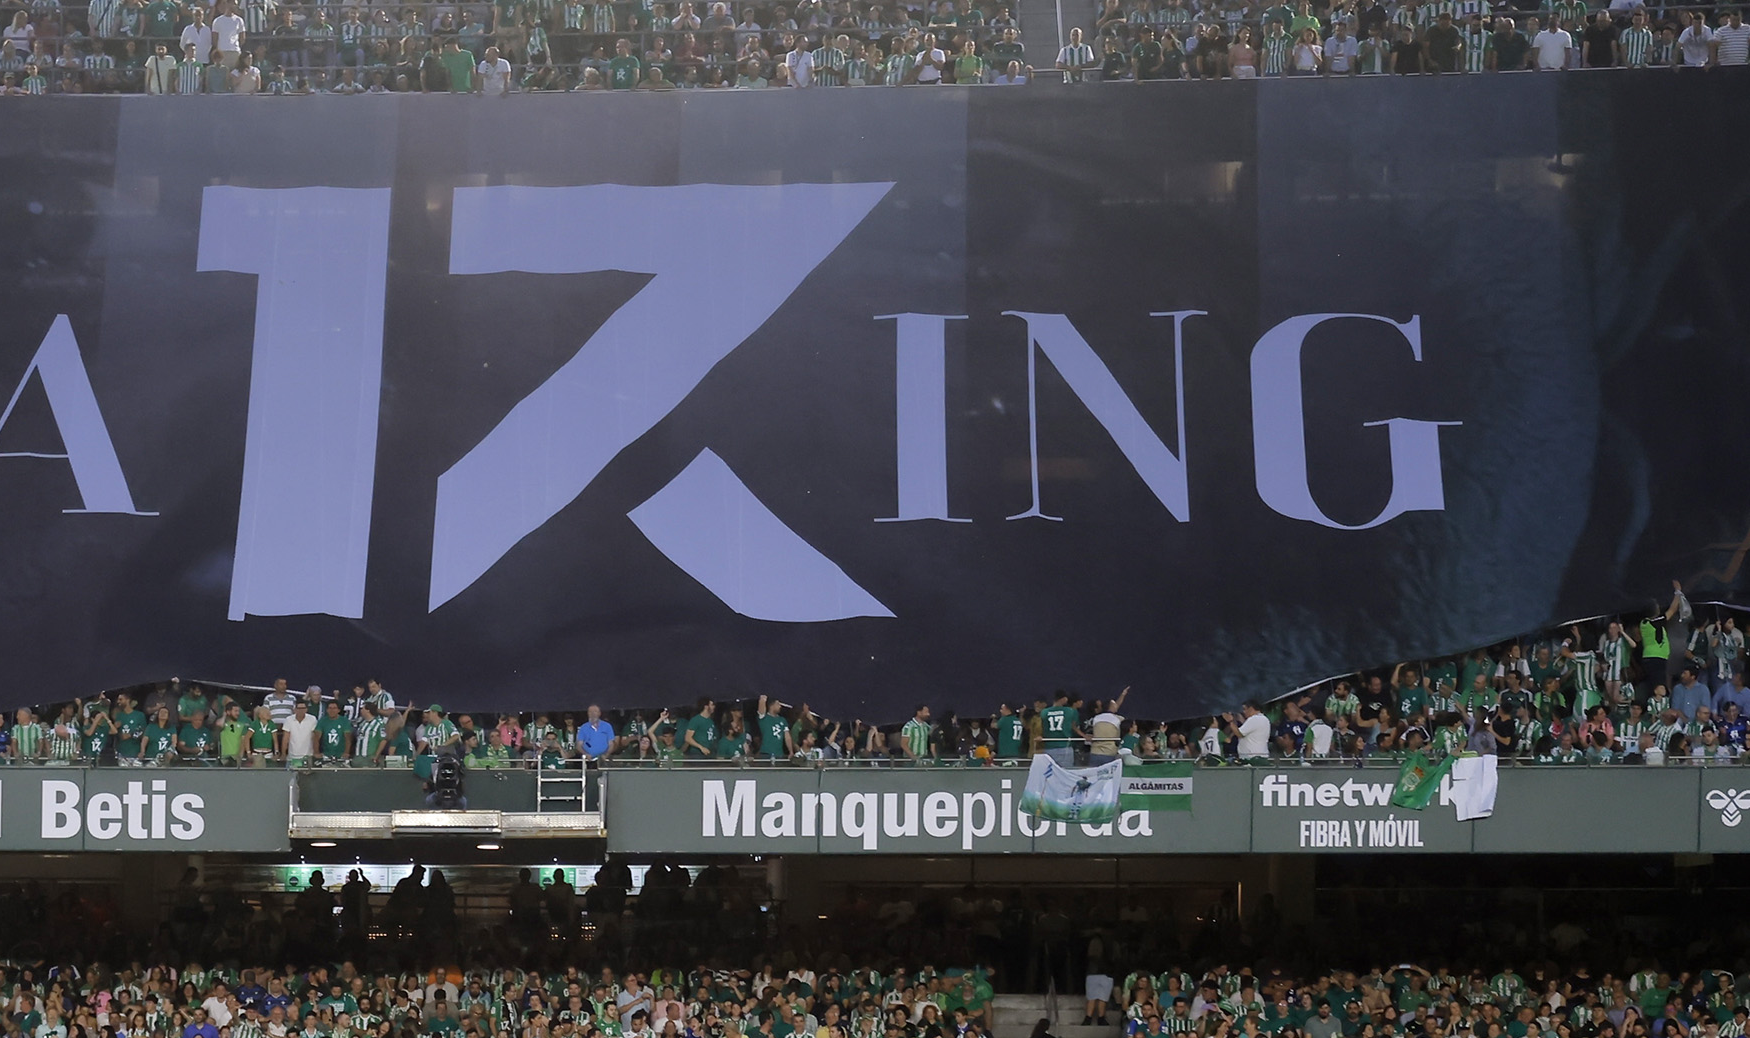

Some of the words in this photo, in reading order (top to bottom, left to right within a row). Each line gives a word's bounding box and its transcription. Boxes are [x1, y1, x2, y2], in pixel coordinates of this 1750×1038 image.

[40, 779, 205, 841] Betis
[701, 778, 1153, 850] Manquepia
[1259, 774, 1454, 806] finetwk
[1299, 819, 1352, 848] FIBRA
[1354, 819, 1365, 848] Y
[1369, 814, 1424, 848] MÓVIL
